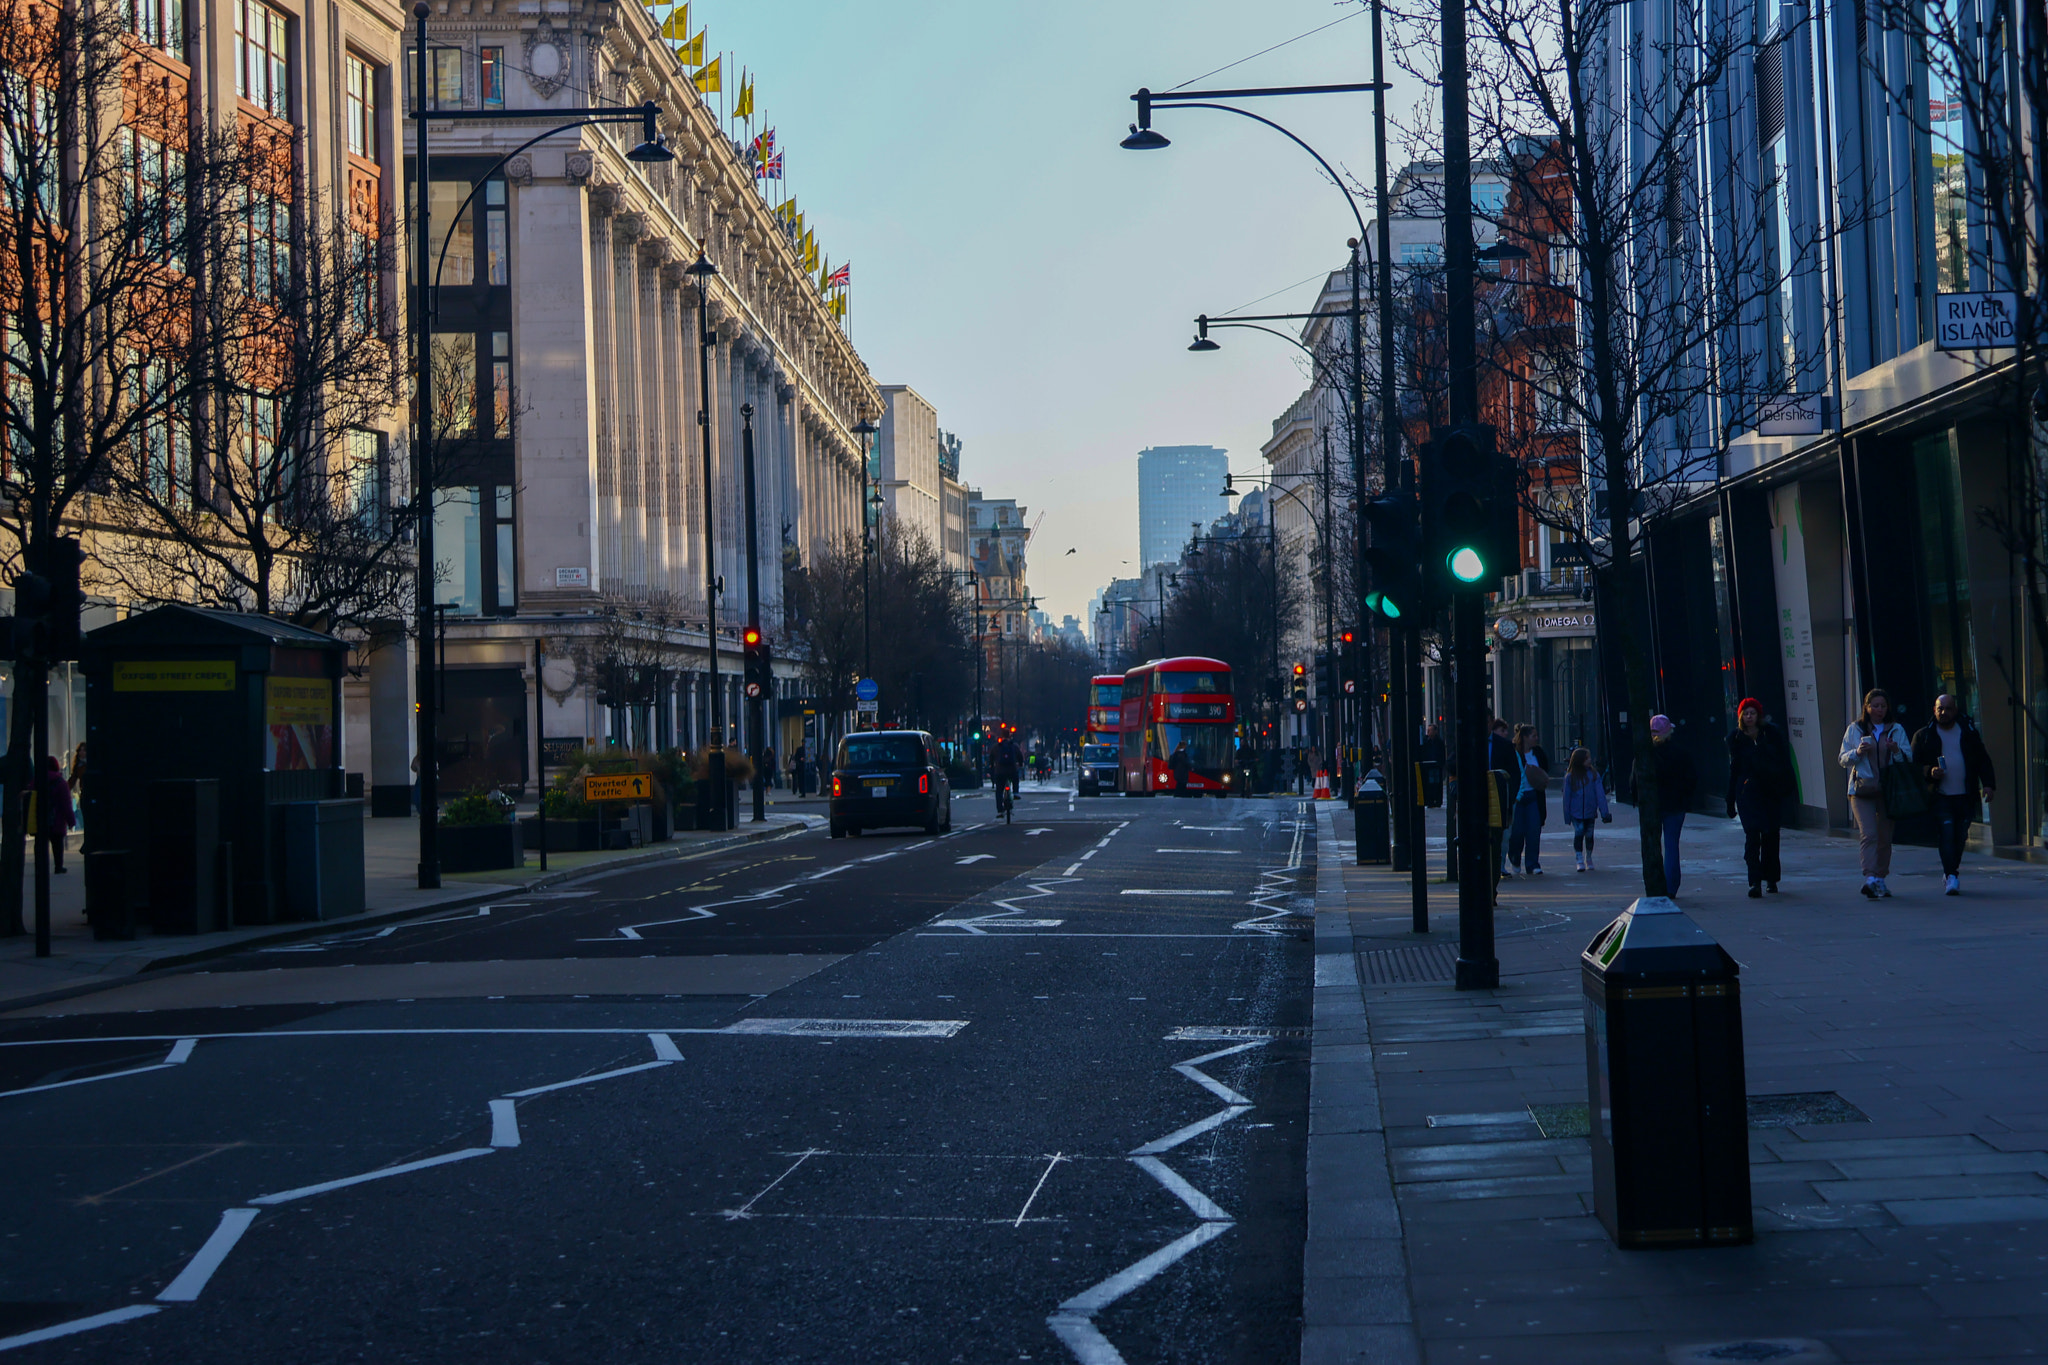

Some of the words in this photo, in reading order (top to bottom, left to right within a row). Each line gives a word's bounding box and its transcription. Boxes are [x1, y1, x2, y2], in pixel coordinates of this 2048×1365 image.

[1949, 300, 2006, 319] RIVER
[1942, 321, 2014, 341] ISLAND
[1764, 408, 1814, 421] Bershka
[1555, 555, 1584, 563] ZARA
[1544, 616, 1579, 627] OMEGA
[121, 672, 158, 680] OXFORD
[160, 672, 192, 680] STREET
[1209, 705, 1222, 715] 390
[589, 779, 627, 789] Diverted
[593, 788, 622, 797] traffic
